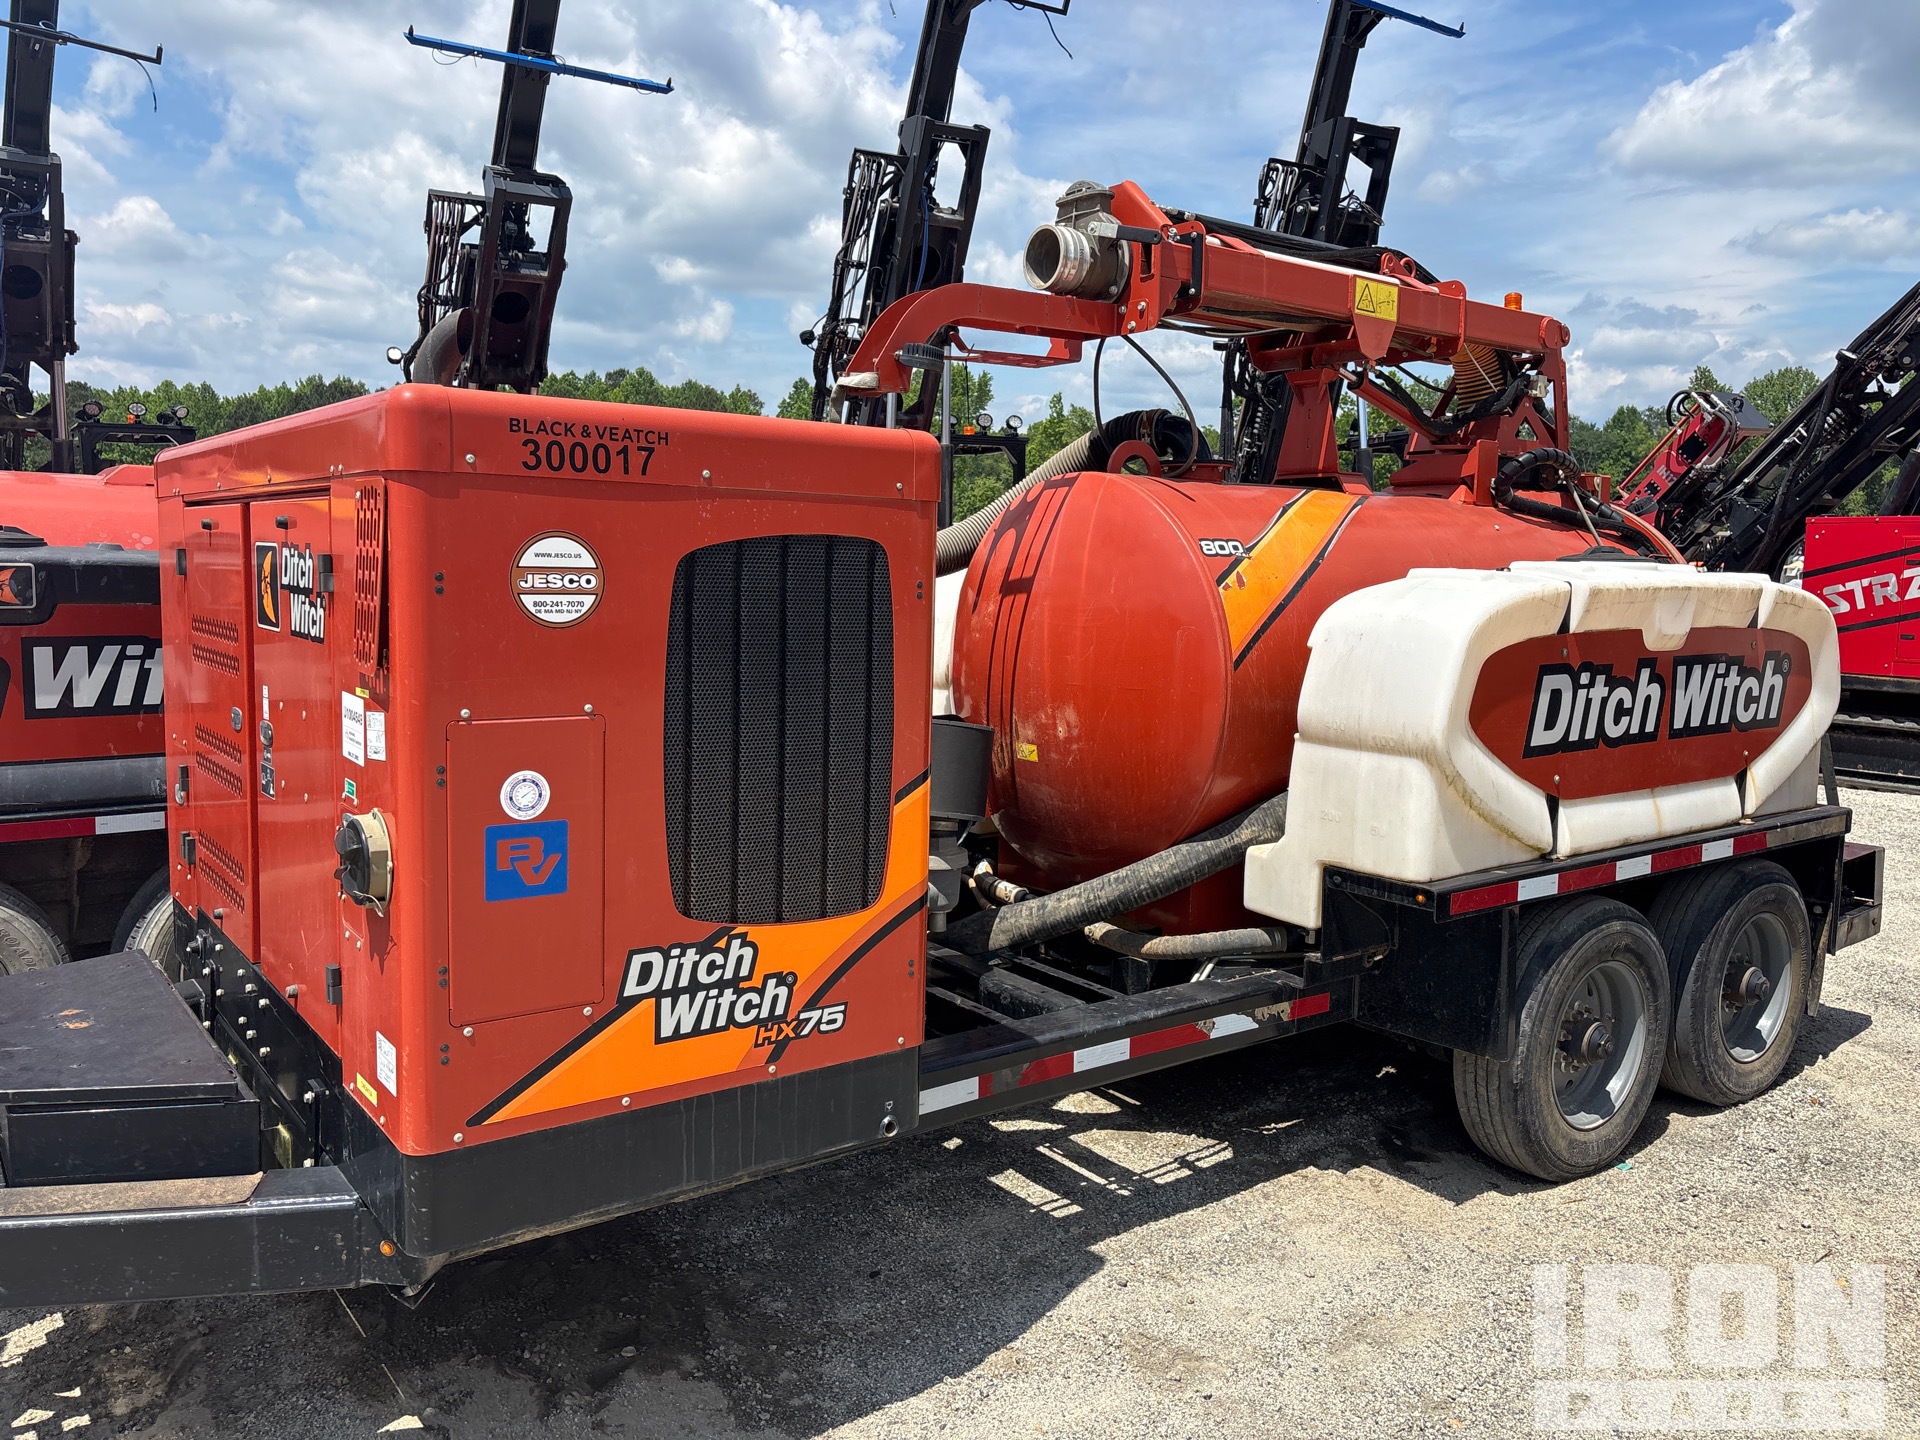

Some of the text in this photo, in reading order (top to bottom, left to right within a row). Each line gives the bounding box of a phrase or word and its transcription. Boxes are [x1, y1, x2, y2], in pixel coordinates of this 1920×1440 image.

[509, 418, 669, 446] BLACK & VEATCH
[521, 438, 656, 476] 300017
[281, 547, 313, 588] Ditch
[1199, 540, 1244, 555] 800
[519, 573, 598, 590] JESCO
[290, 592, 325, 639] Witch
[533, 600, 585, 608] 800-241-7070
[1530, 660, 1784, 747] Ditch Witch
[623, 938, 754, 997] Ditch
[660, 978, 789, 1039] Witch
[758, 1004, 846, 1044] HX75
